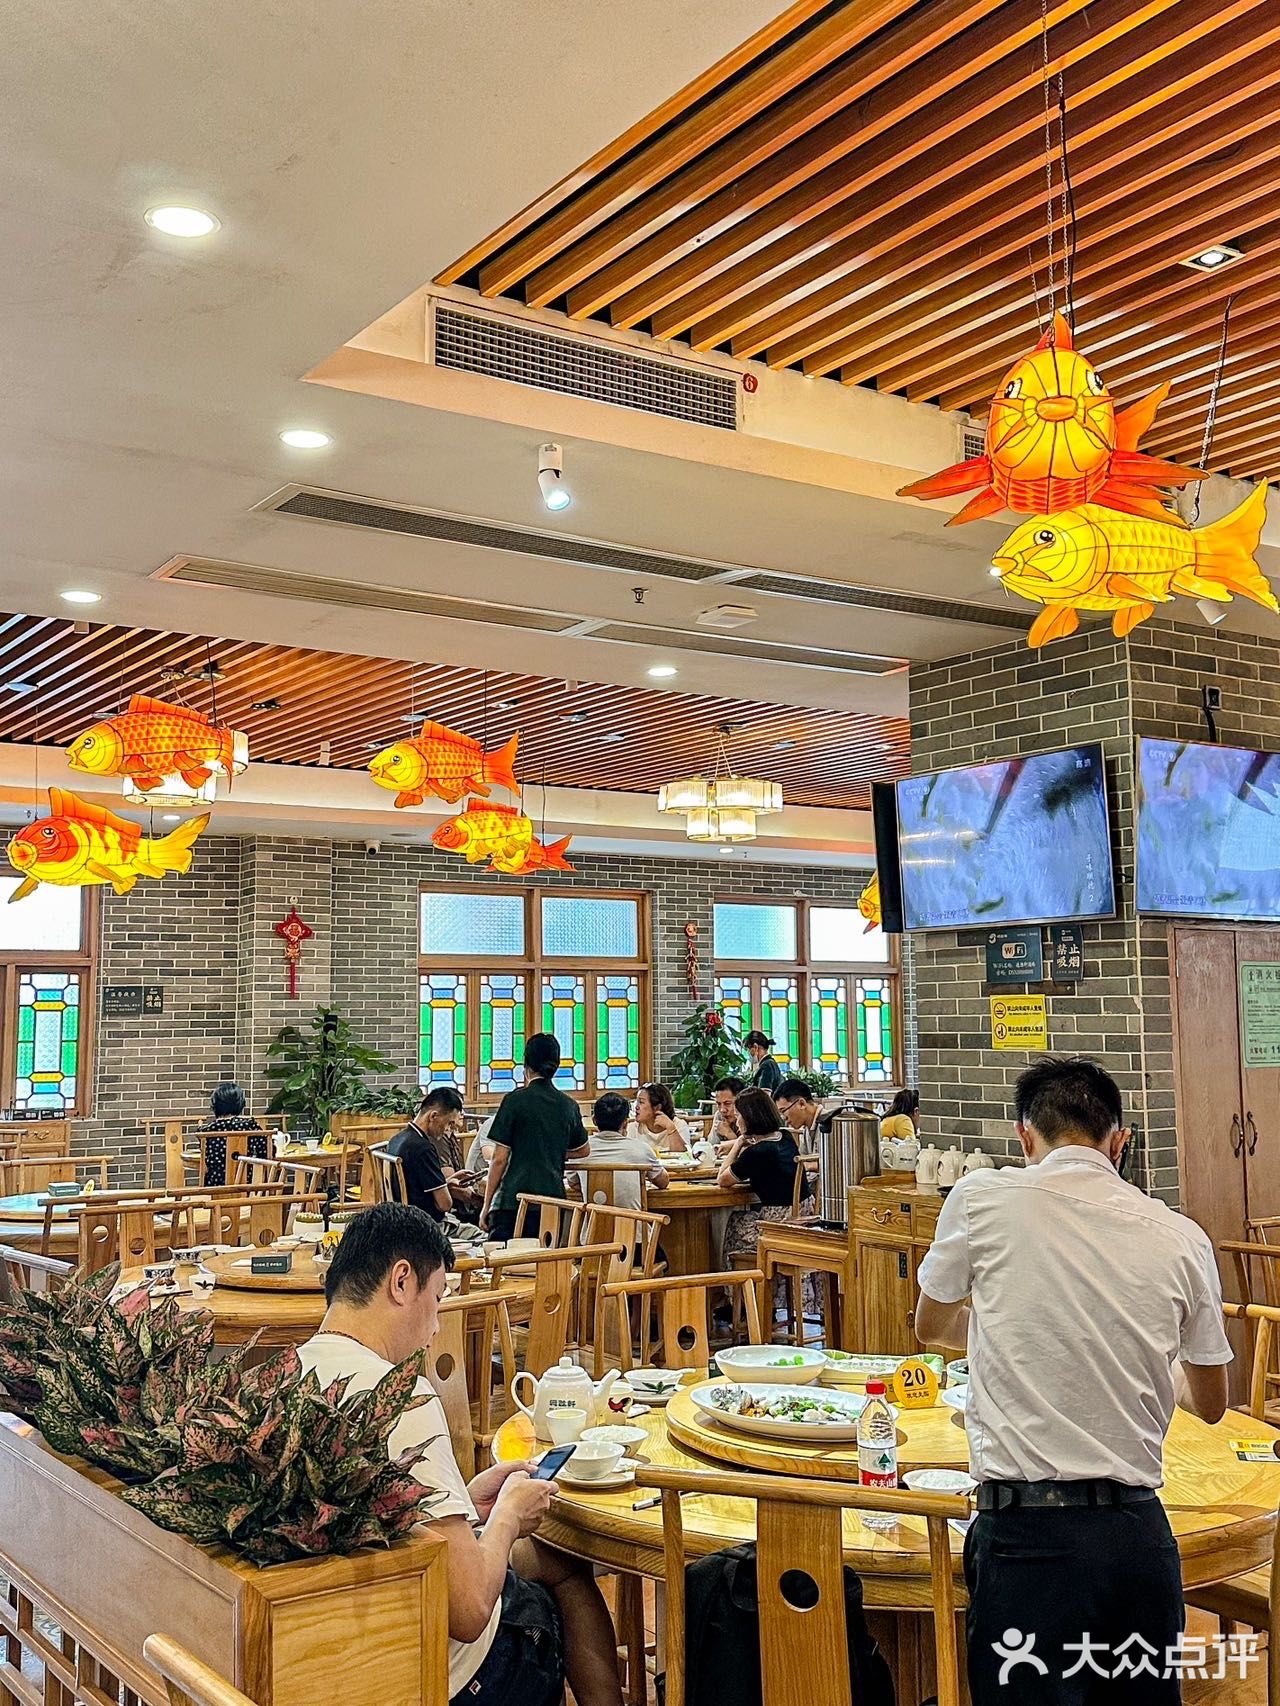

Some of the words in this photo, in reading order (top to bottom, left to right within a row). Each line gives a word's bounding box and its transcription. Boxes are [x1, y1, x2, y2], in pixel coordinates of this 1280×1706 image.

[745, 375, 754, 390] 6
[1056, 943, 1080, 955] 禁止
[1056, 955, 1080, 968] 吸烟
[901, 1367, 926, 1387] 20
